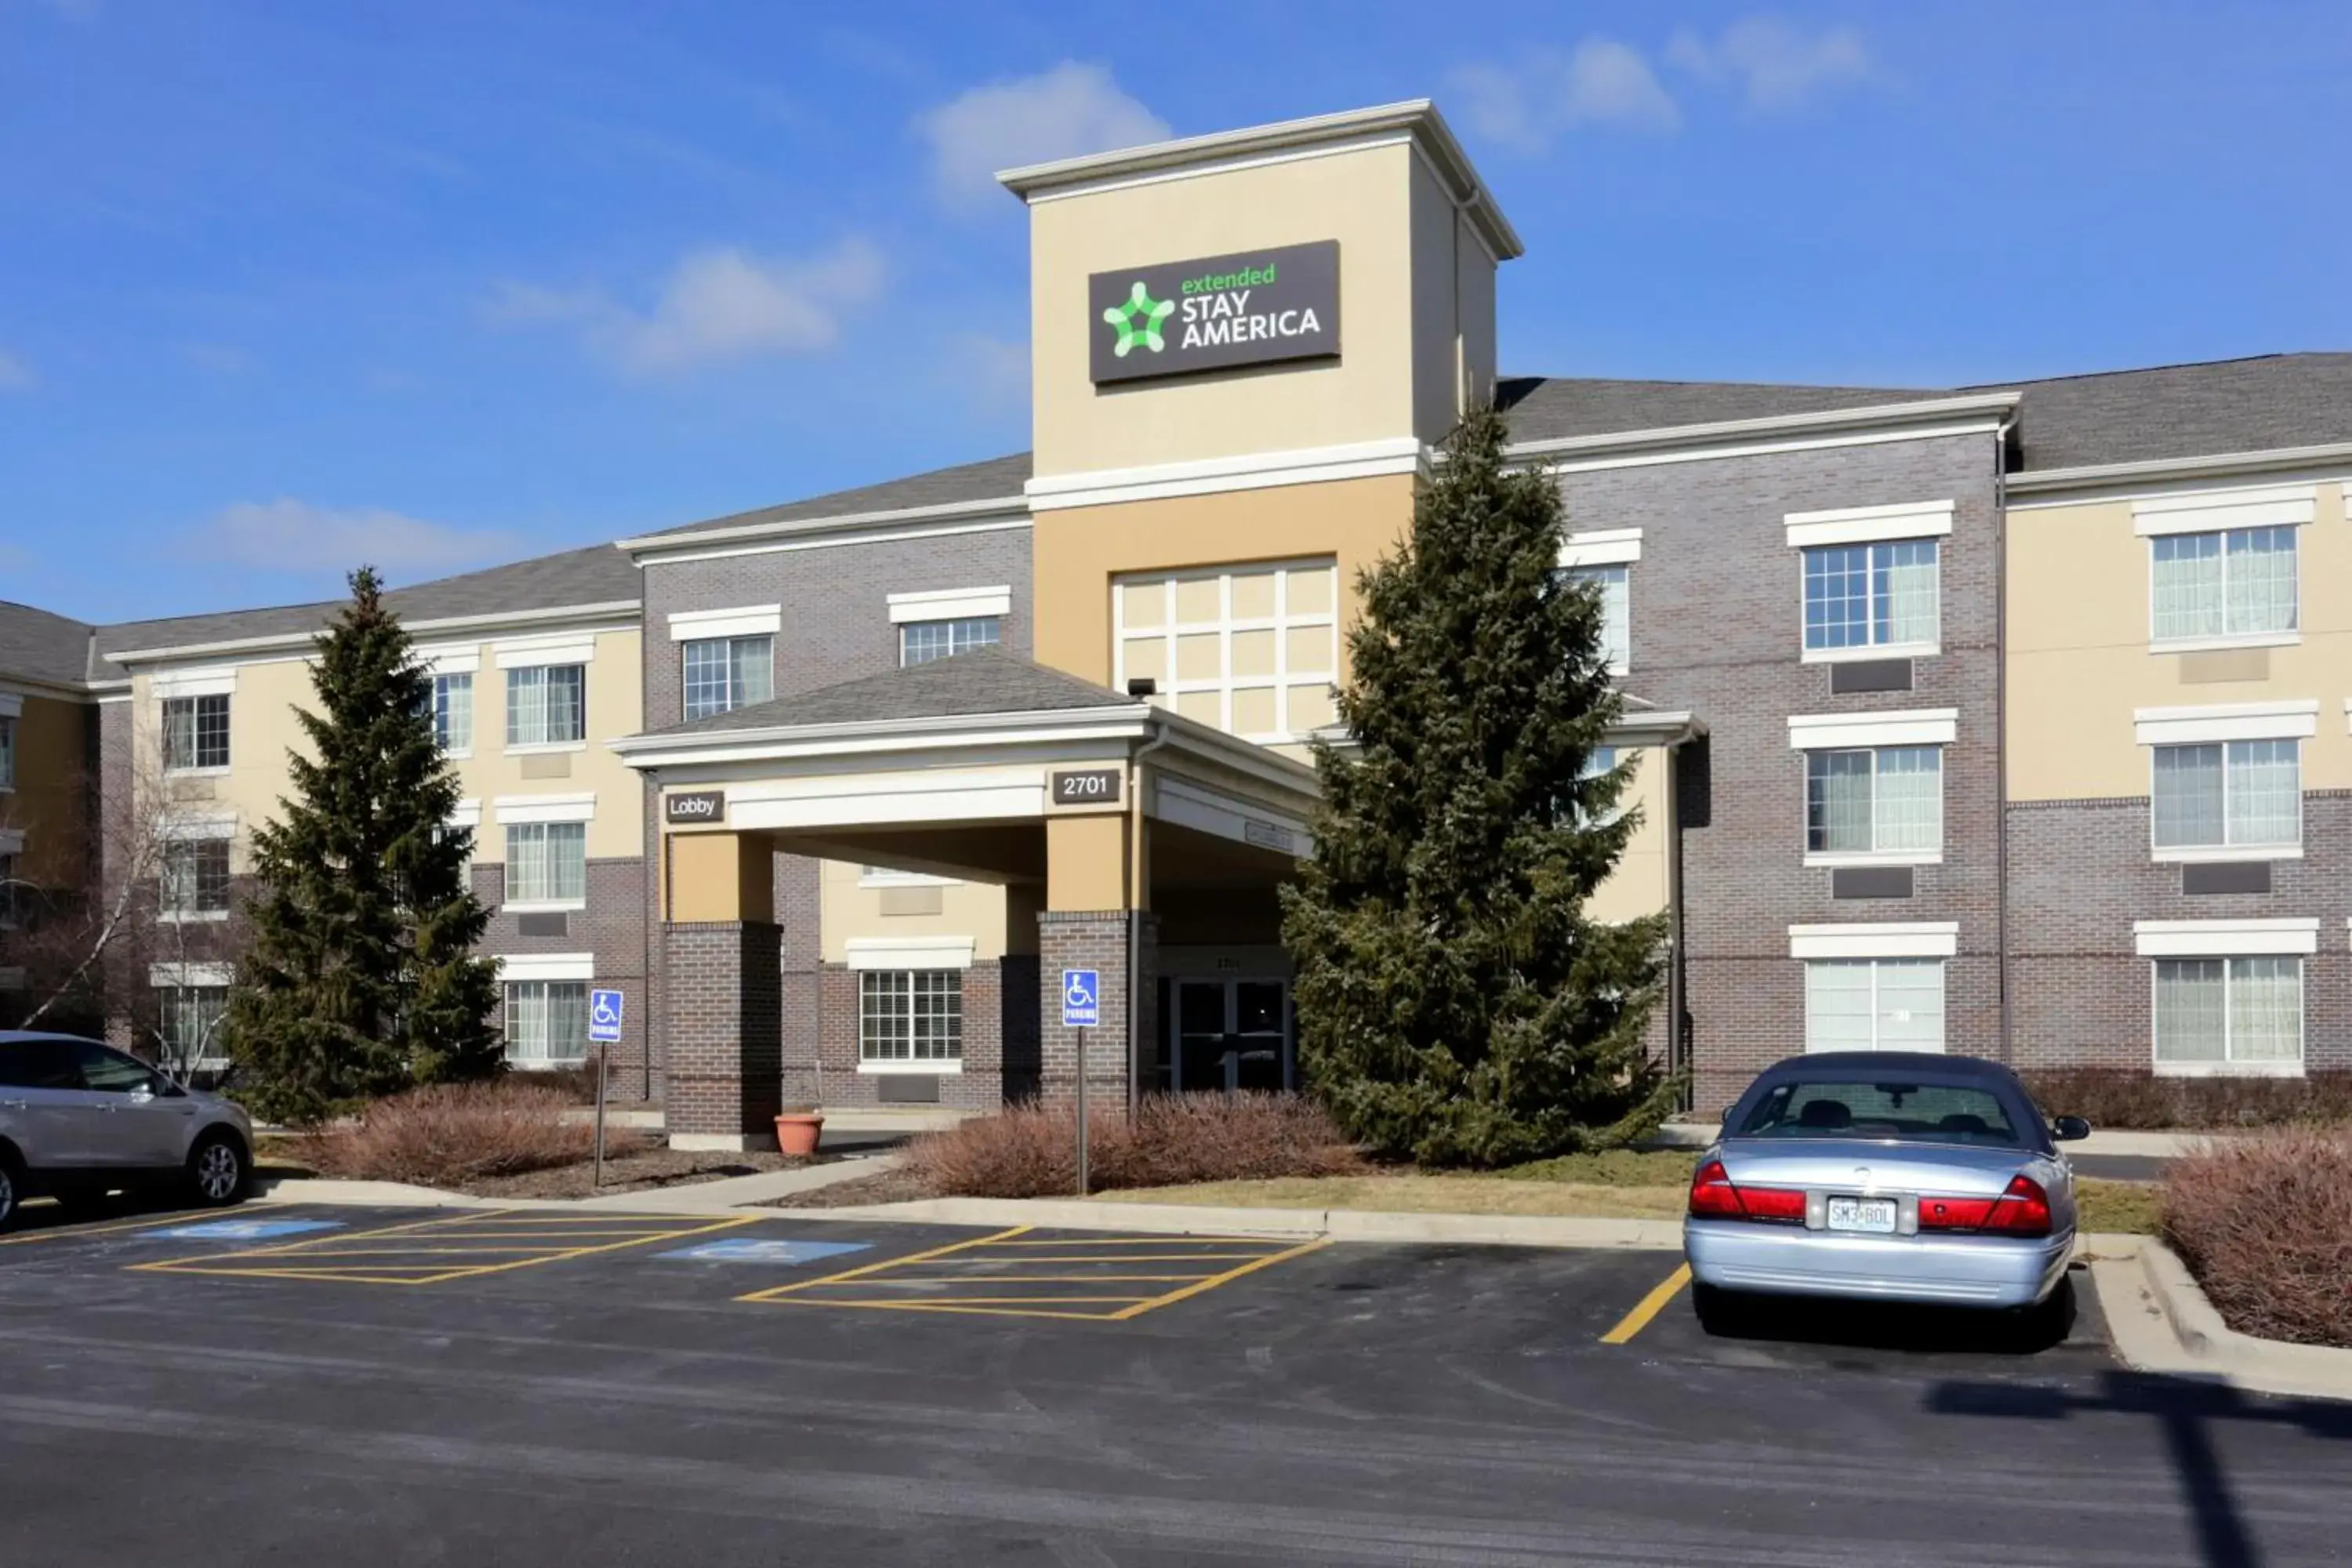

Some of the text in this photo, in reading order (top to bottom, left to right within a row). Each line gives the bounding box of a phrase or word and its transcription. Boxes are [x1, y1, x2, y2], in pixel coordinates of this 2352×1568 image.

[1181, 263, 1275, 295] extended
[1181, 290, 1250, 322] STAY
[1181, 308, 1320, 349] AMERICA
[1064, 775, 1106, 796] 2701
[670, 797, 715, 816] Lobby
